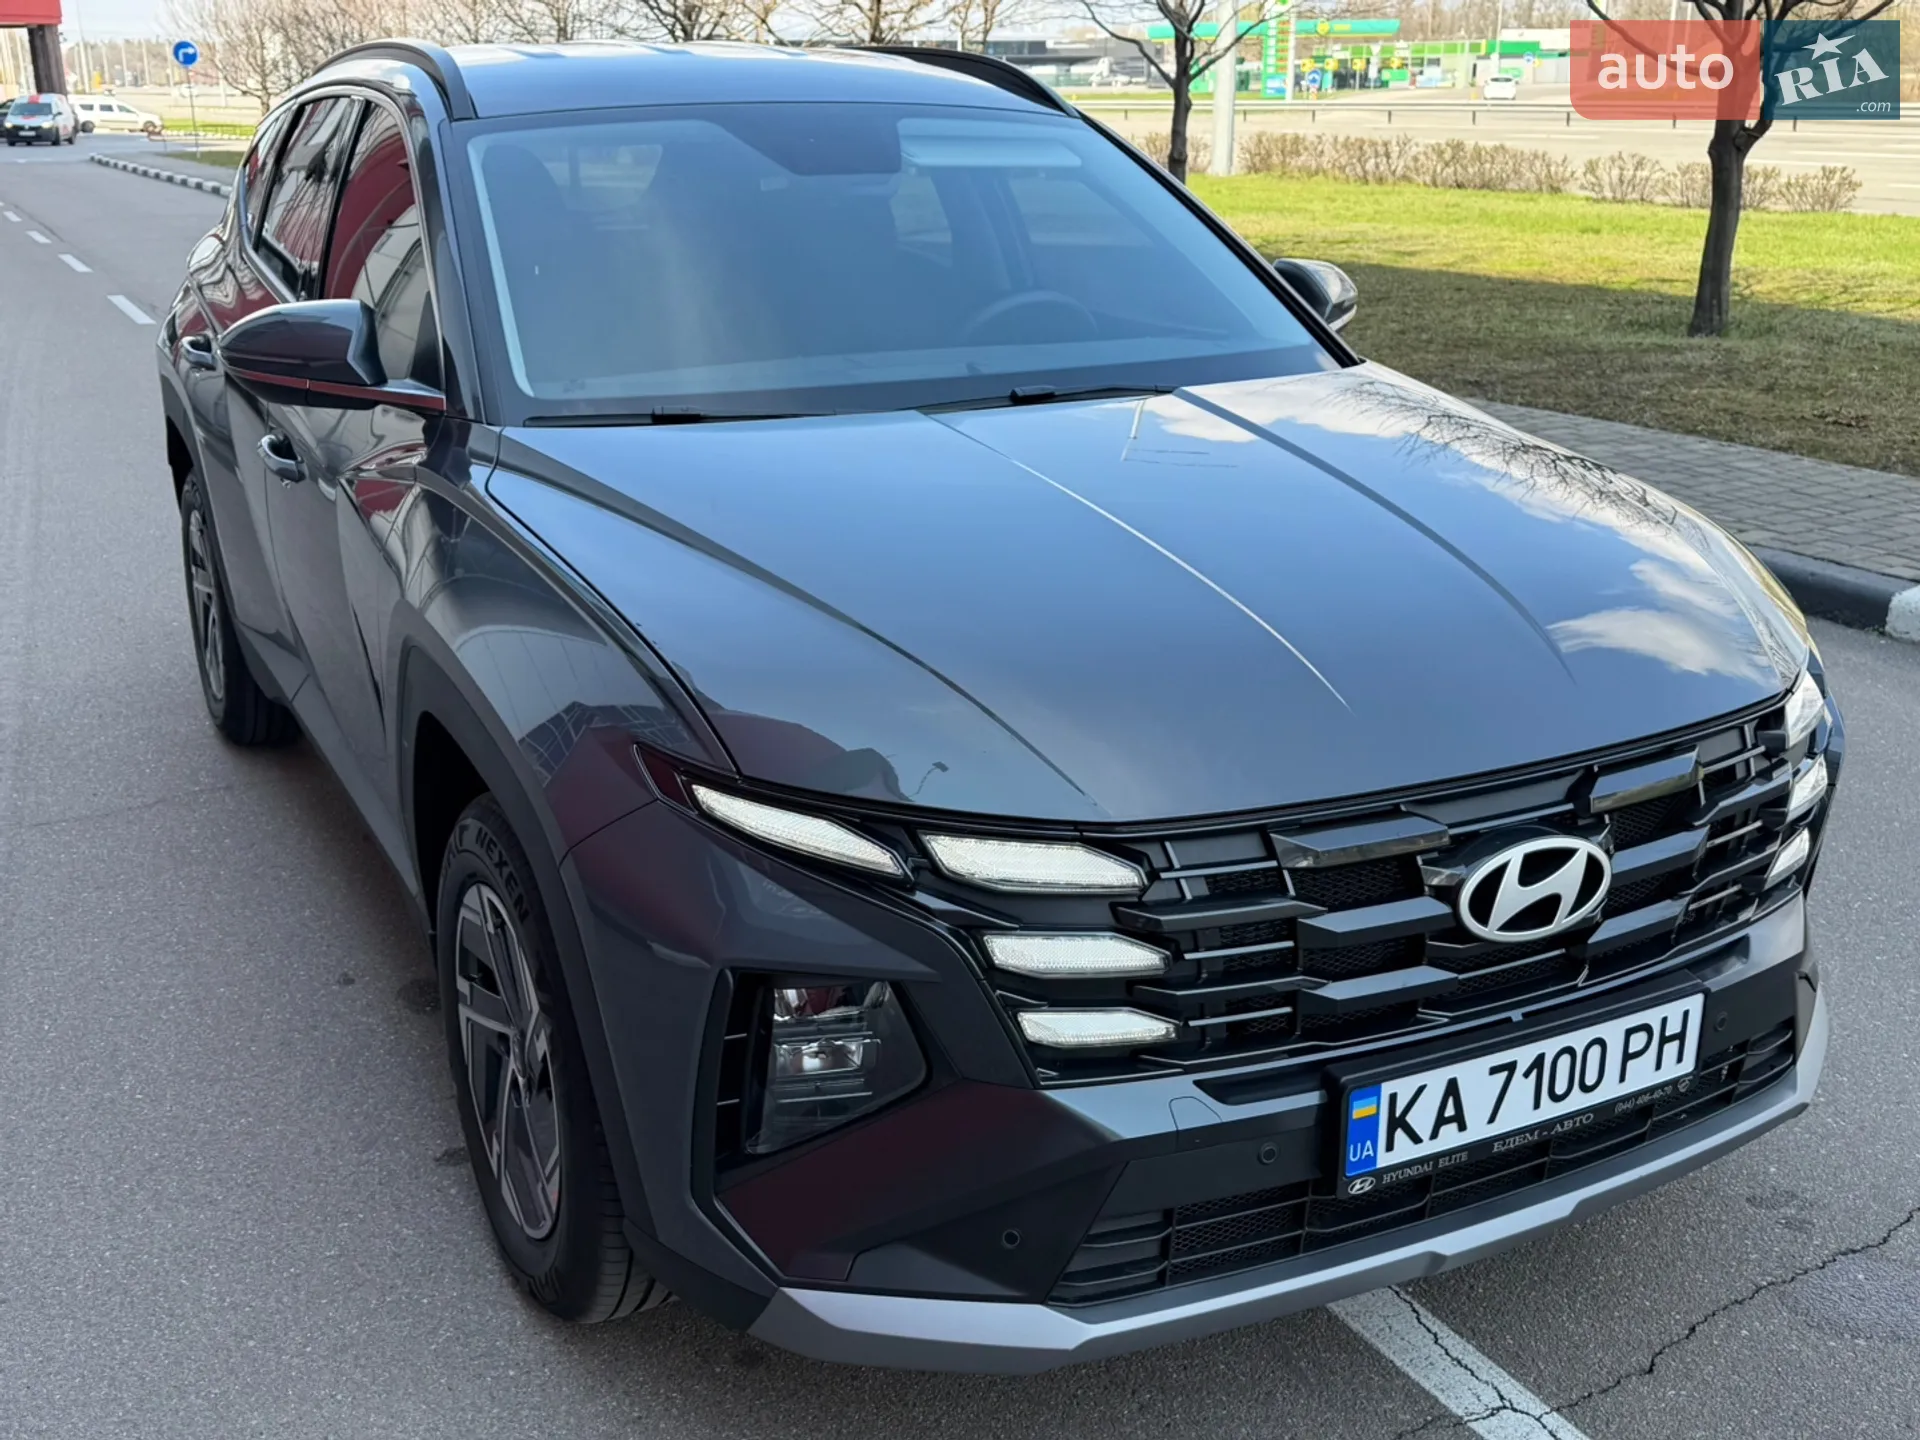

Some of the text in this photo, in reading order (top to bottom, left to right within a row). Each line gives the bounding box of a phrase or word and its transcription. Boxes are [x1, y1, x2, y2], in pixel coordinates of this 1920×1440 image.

[474, 826, 530, 925] NEXEN
[1384, 1007, 1691, 1154] KA 7100 PH
[1550, 1112, 1595, 1135] АВТО
[1349, 1140, 1374, 1162] UA
[1382, 1151, 1469, 1184] HYUNDAI ELITE
